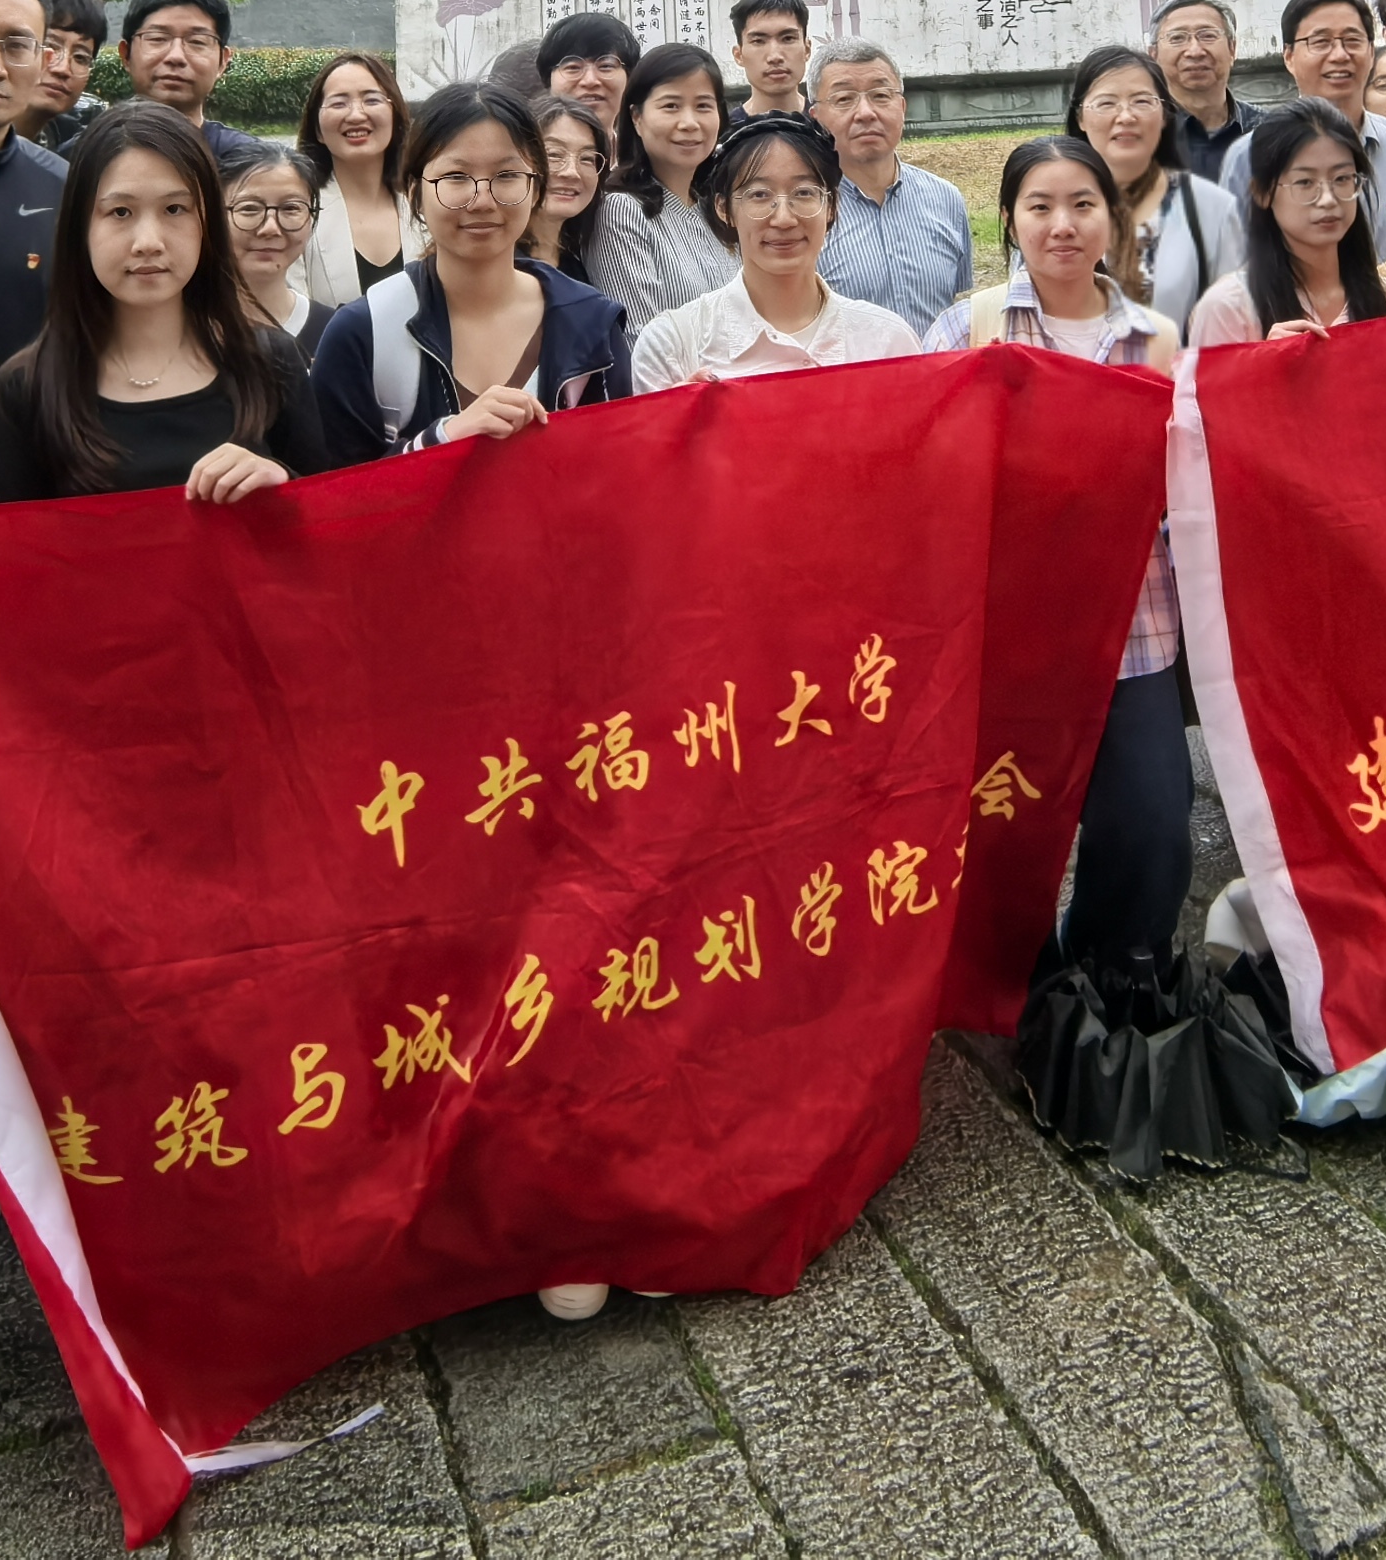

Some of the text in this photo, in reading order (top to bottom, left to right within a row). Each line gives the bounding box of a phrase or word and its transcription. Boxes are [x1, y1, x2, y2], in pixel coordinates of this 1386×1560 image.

[356, 633, 897, 867] 中共福州大学
